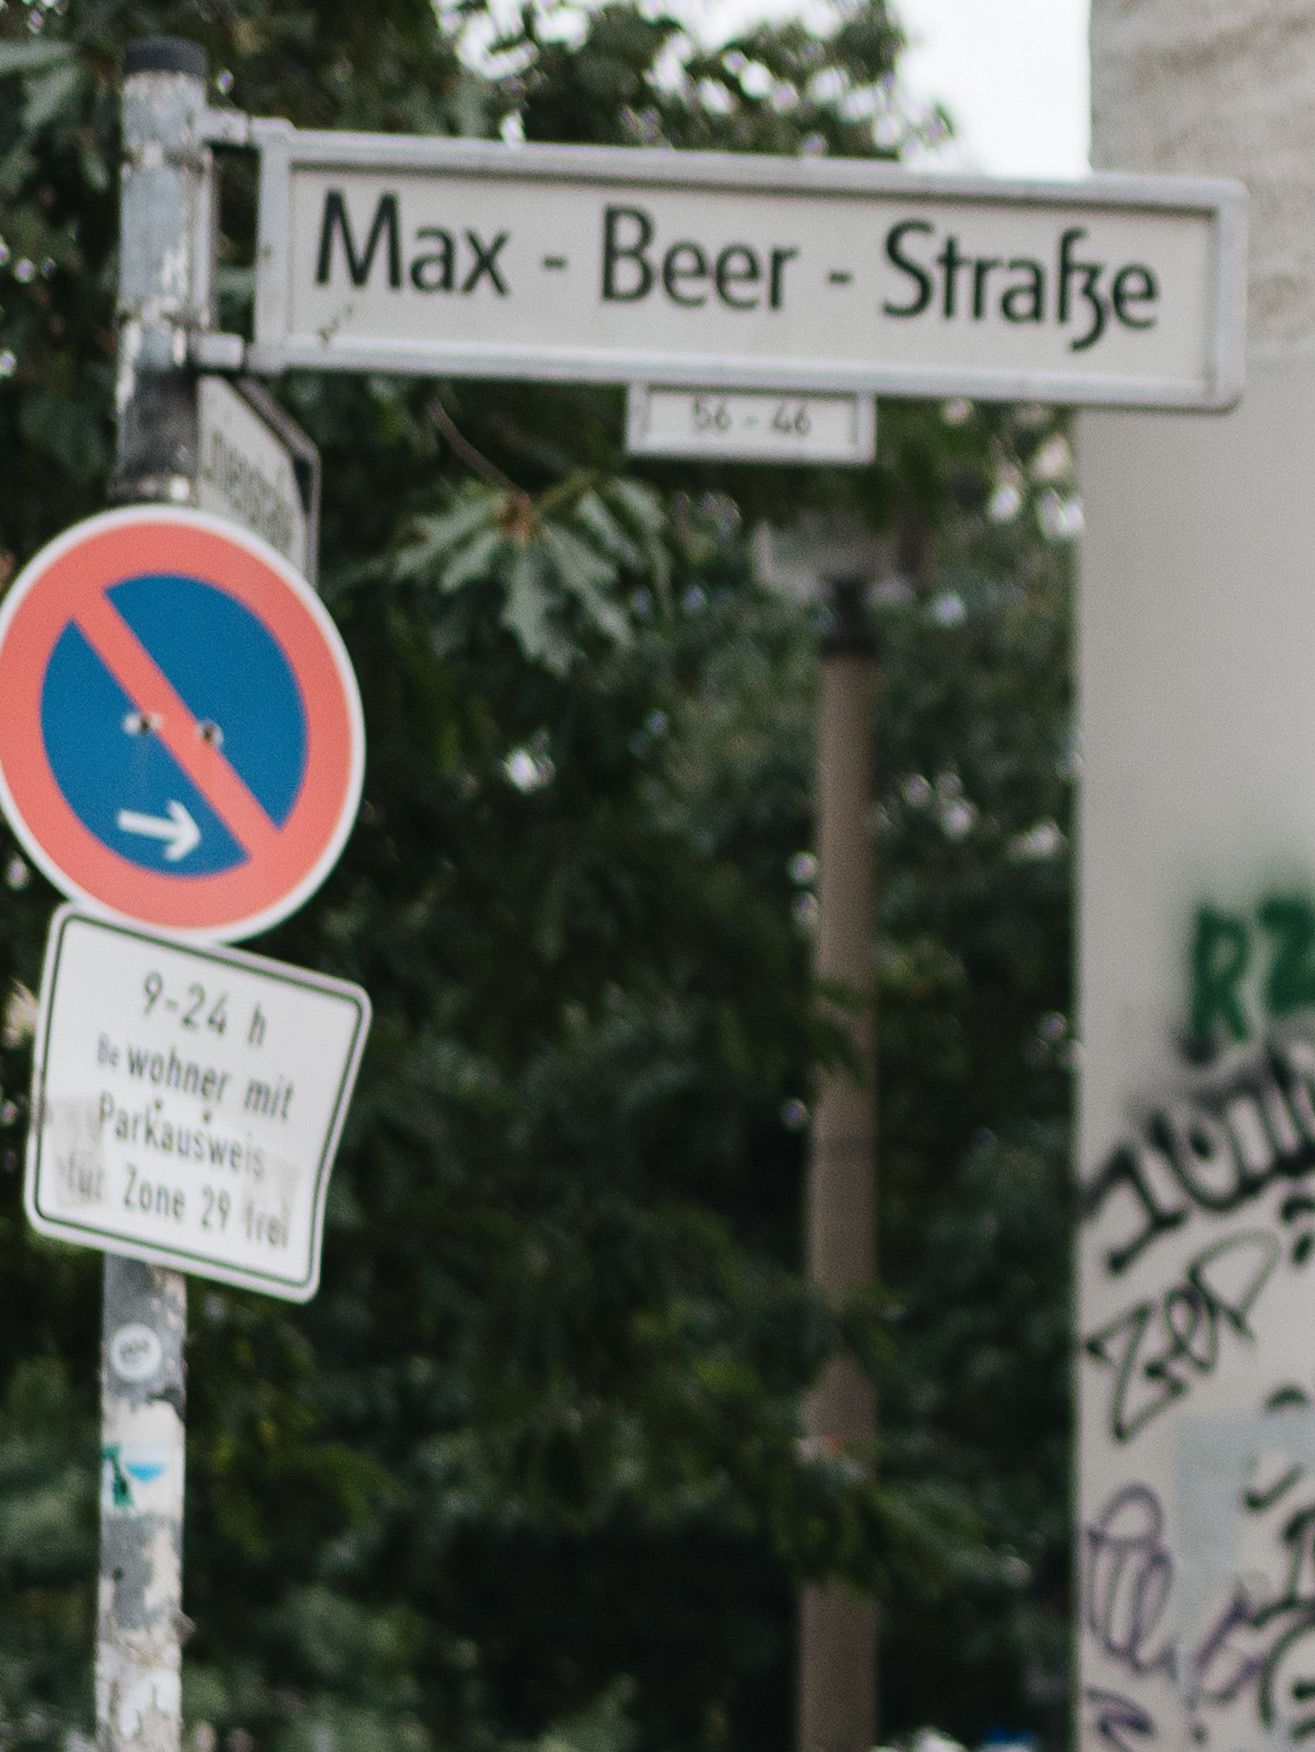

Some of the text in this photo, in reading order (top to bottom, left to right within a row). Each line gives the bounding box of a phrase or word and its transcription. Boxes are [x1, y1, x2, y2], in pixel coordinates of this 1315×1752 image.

[315, 188, 510, 297] Max
[602, 205, 800, 311] Beer
[882, 220, 1159, 352] Straße
[142, 970, 267, 1047] 9-24 h
[244, 1073, 295, 1123] mit
[99, 1091, 265, 1184] Parkausweis
[123, 1162, 185, 1221] Zone
